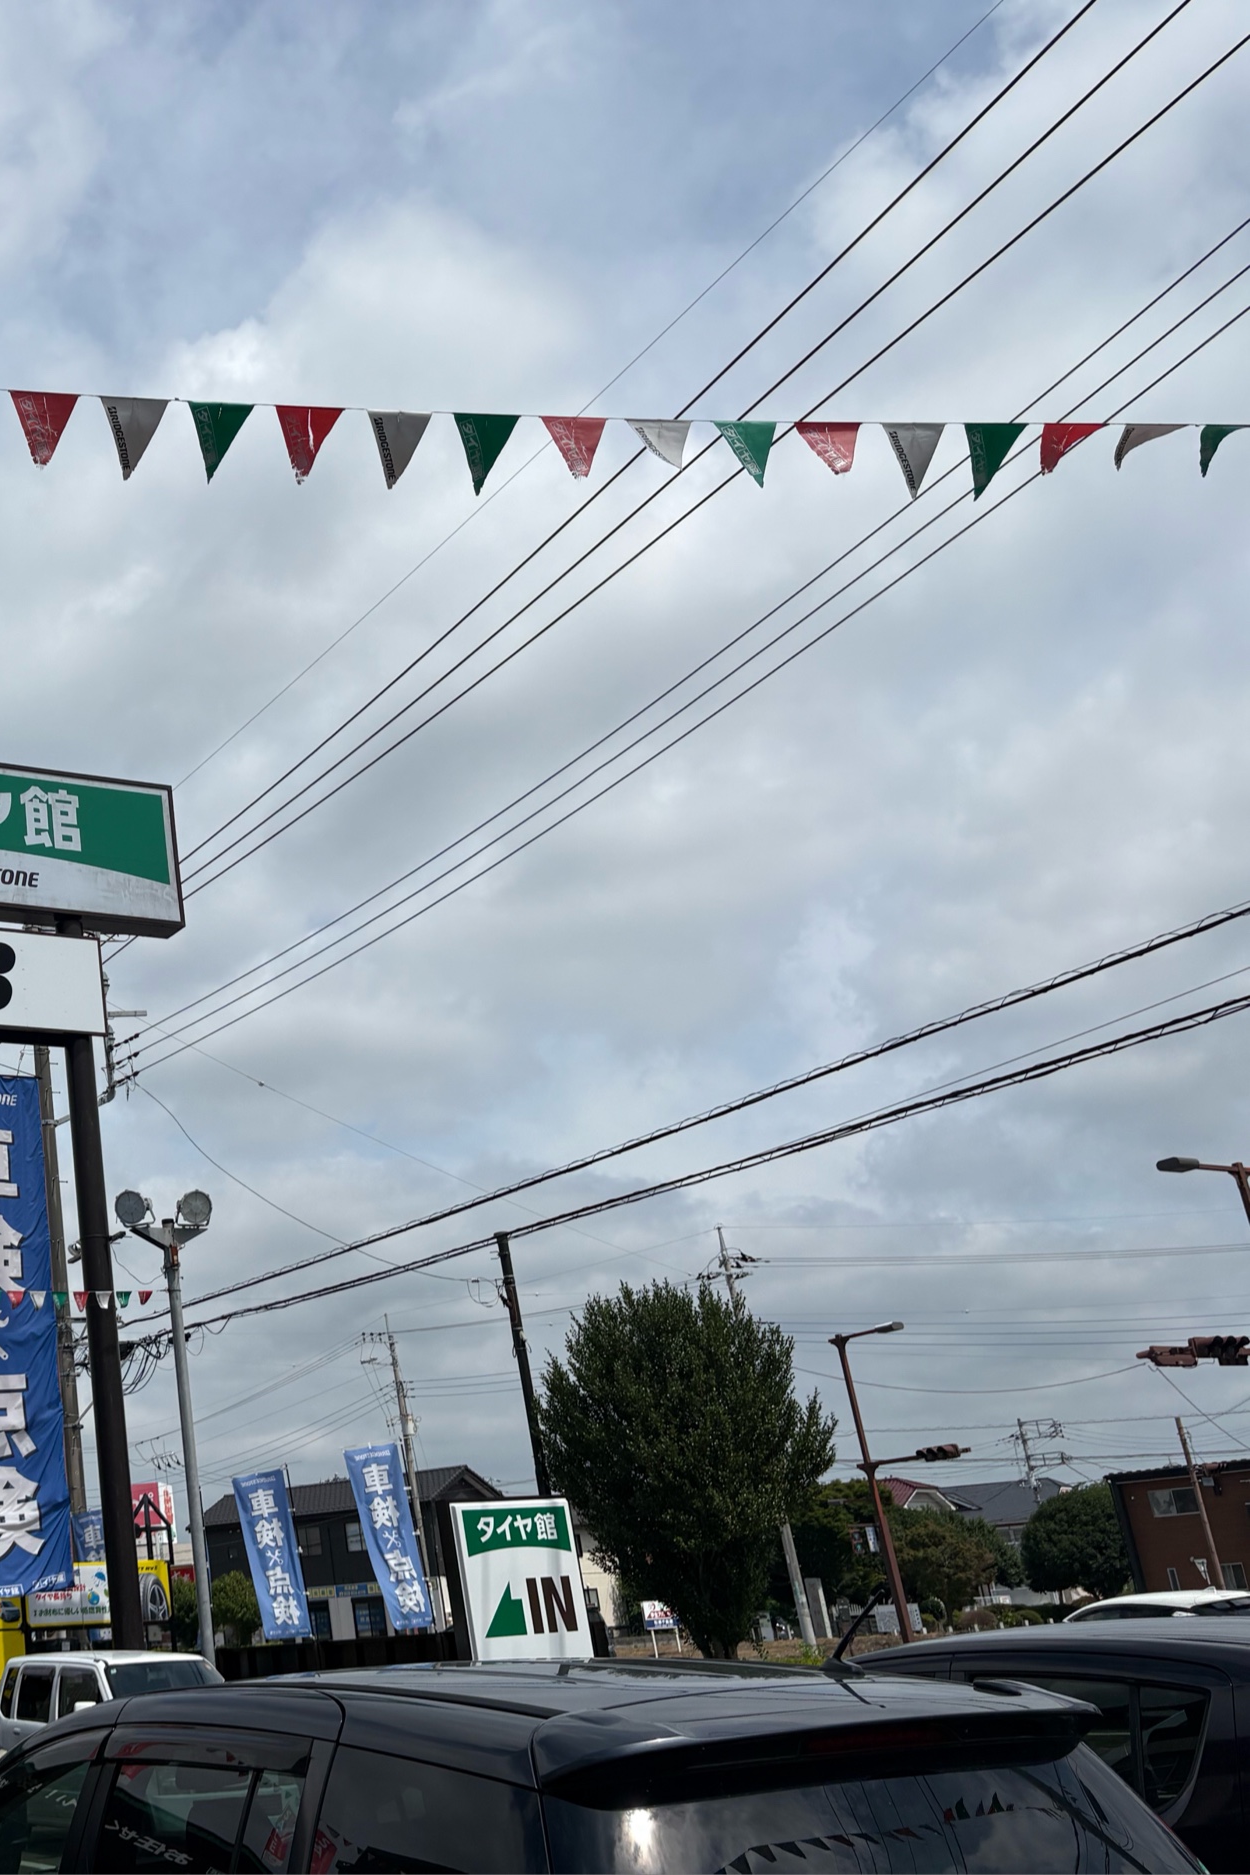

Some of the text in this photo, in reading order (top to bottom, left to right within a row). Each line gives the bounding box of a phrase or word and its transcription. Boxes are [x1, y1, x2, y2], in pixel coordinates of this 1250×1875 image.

[107, 406, 131, 471] BRIDGESTONE
[373, 417, 397, 481] BRIDGESTONE
[888, 431, 917, 491] BRIDGESTONE
[476, 1512, 558, 1544] タイヤ館
[526, 1575, 579, 1634] IN
